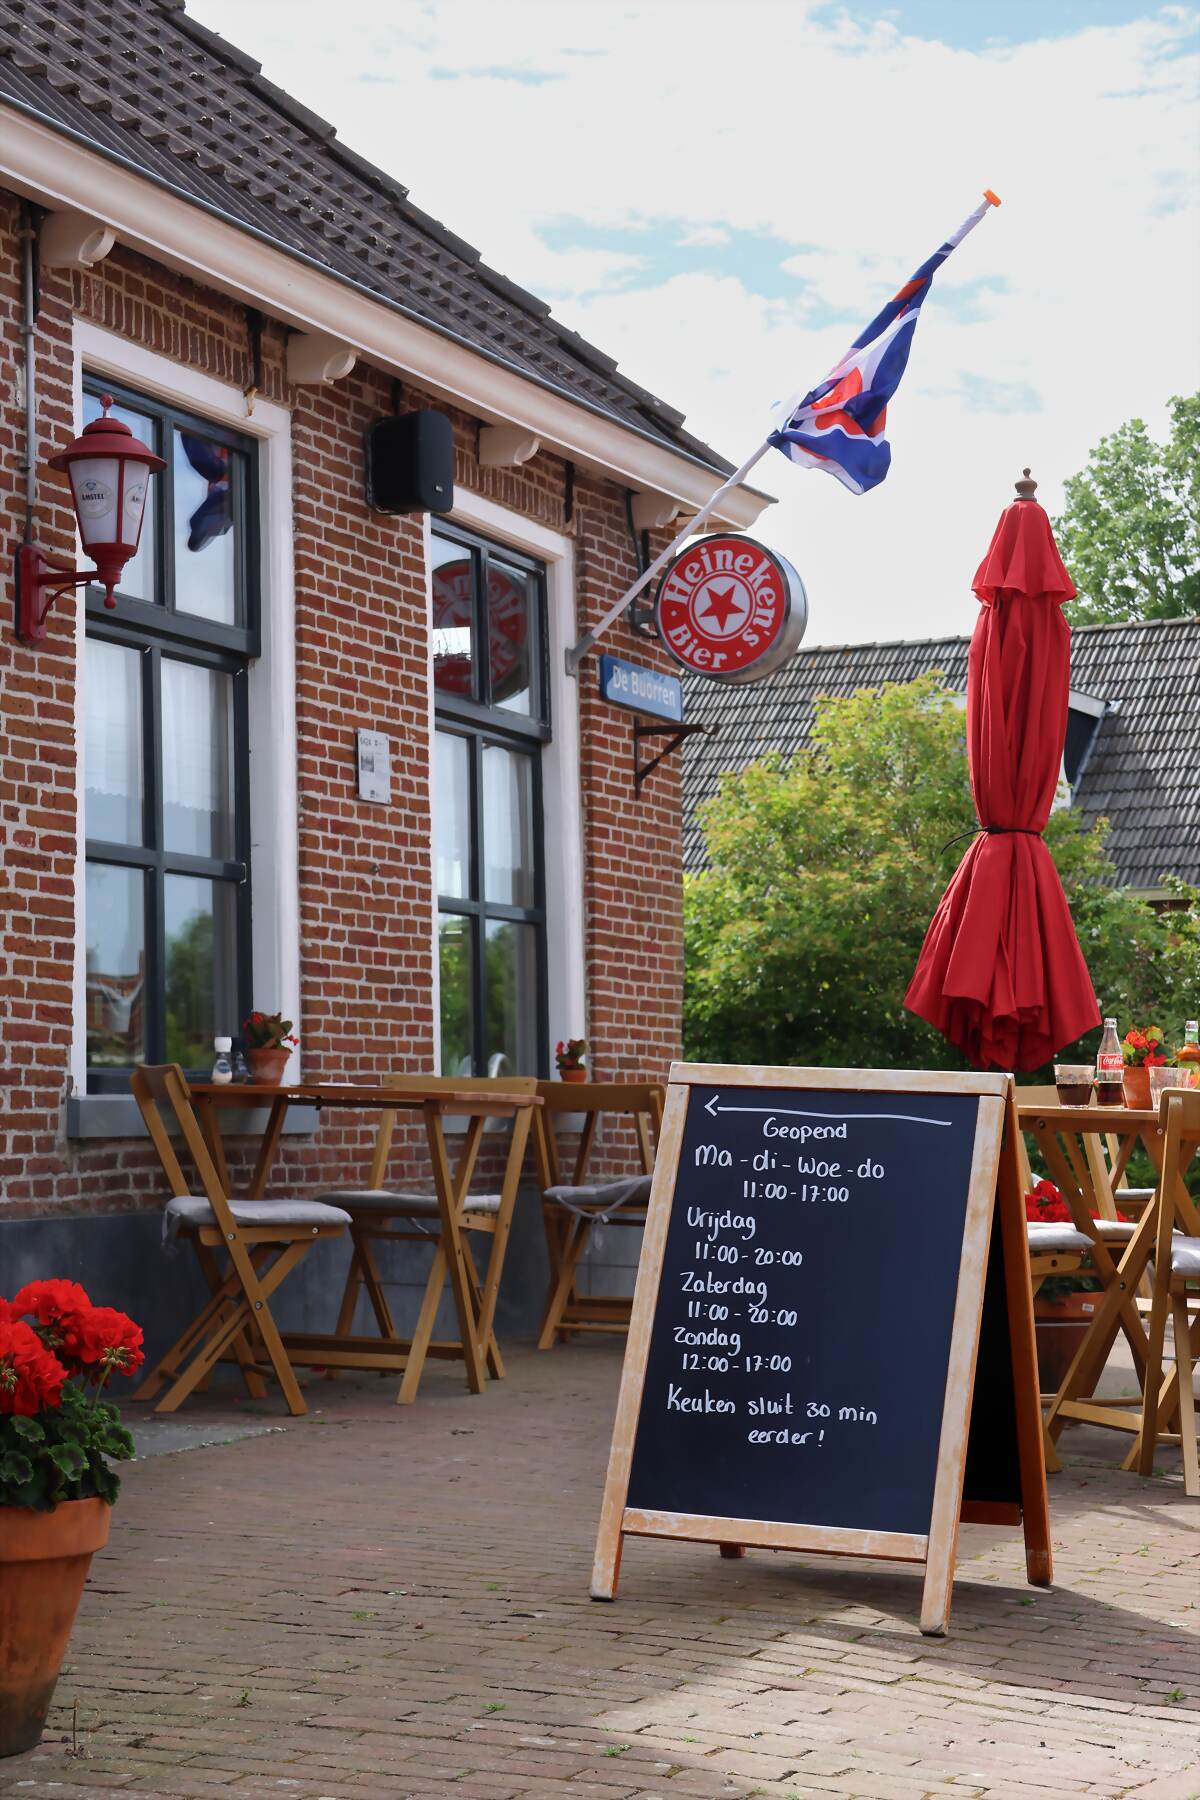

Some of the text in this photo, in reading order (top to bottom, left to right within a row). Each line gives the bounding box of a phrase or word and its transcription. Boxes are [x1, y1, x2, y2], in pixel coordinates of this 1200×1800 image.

[664, 546, 777, 647] Heineken's
[668, 624, 728, 668] Bier
[612, 665, 676, 708] De Buorren
[763, 1117, 847, 1143] Geopend
[679, 1271, 768, 1306] Zaterdag
[673, 1326, 741, 1357] Zondag
[667, 1383, 878, 1425] Keuken sluit 30 min
